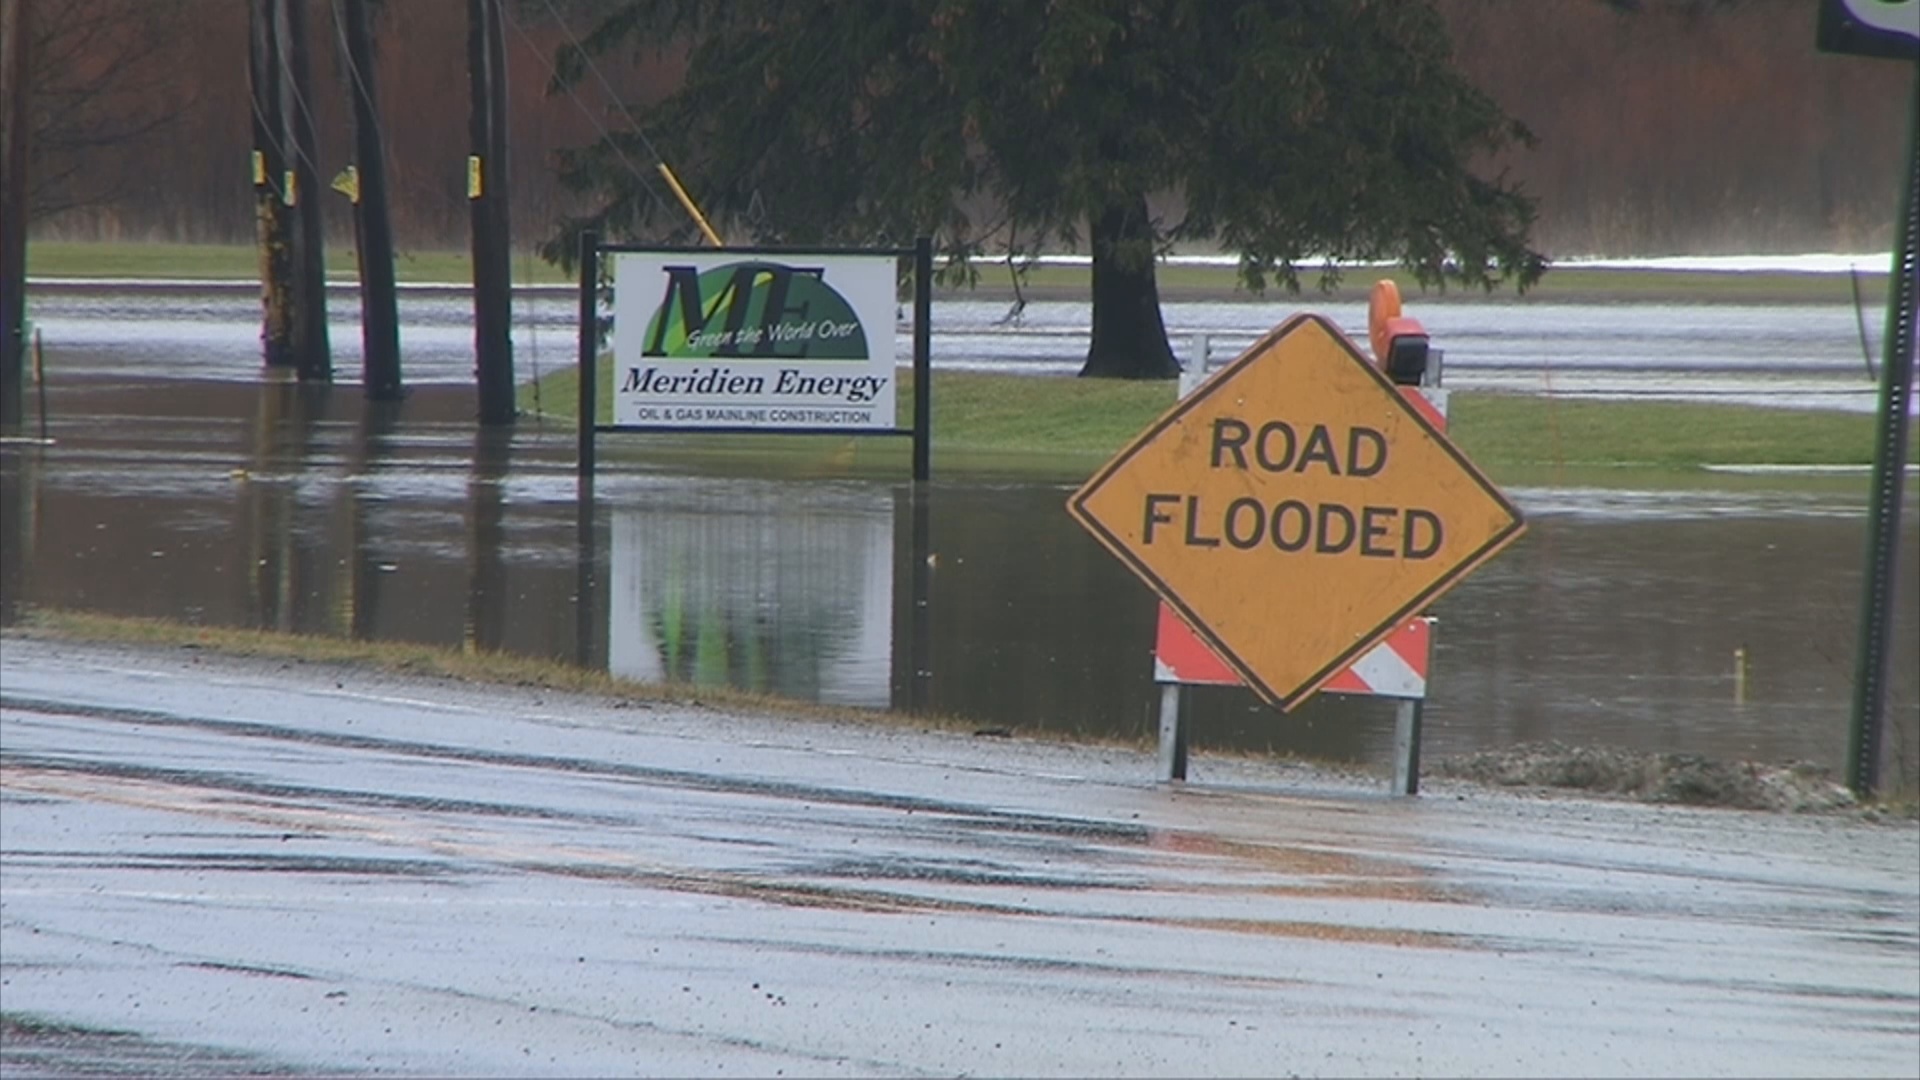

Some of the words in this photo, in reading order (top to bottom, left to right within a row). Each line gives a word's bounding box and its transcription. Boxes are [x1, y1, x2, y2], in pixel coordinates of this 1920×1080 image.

[641, 265, 825, 358] ME
[687, 328, 733, 349] Green
[735, 325, 761, 345] the
[768, 320, 816, 342] World
[819, 318, 857, 341] Over
[621, 367, 763, 395] Meridien
[773, 368, 887, 401] Energy
[638, 408, 661, 421] OIL
[664, 408, 672, 421] &
[676, 408, 702, 421] GAS
[706, 408, 767, 422] MAINLINE
[769, 409, 871, 424] CONSTRUCTION
[1210, 418, 1388, 477] ROAD
[1142, 494, 1443, 560] FLOODED
